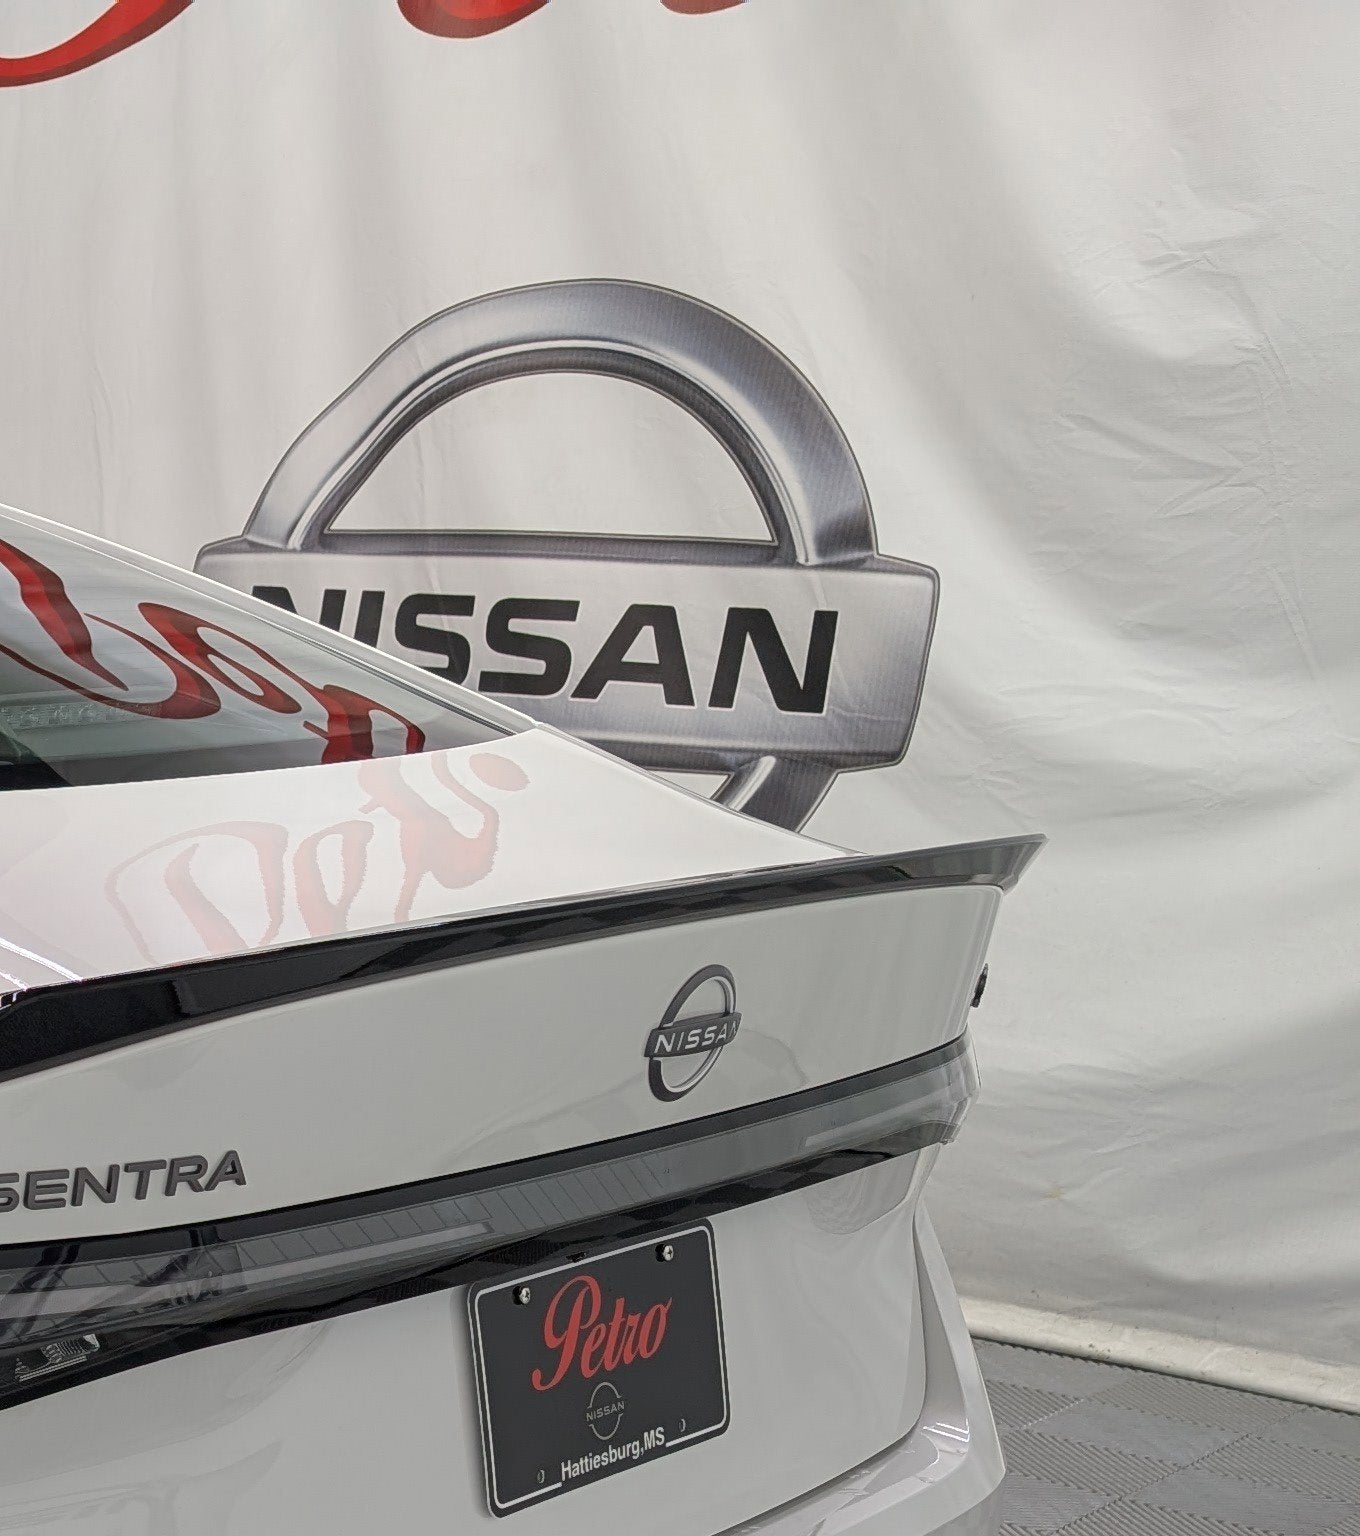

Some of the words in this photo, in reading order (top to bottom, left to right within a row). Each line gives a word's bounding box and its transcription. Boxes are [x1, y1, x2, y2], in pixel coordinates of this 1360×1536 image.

[654, 1020, 738, 1054] NISSAN
[531, 1275, 673, 1392] Petro
[585, 1399, 626, 1423] NISSAN
